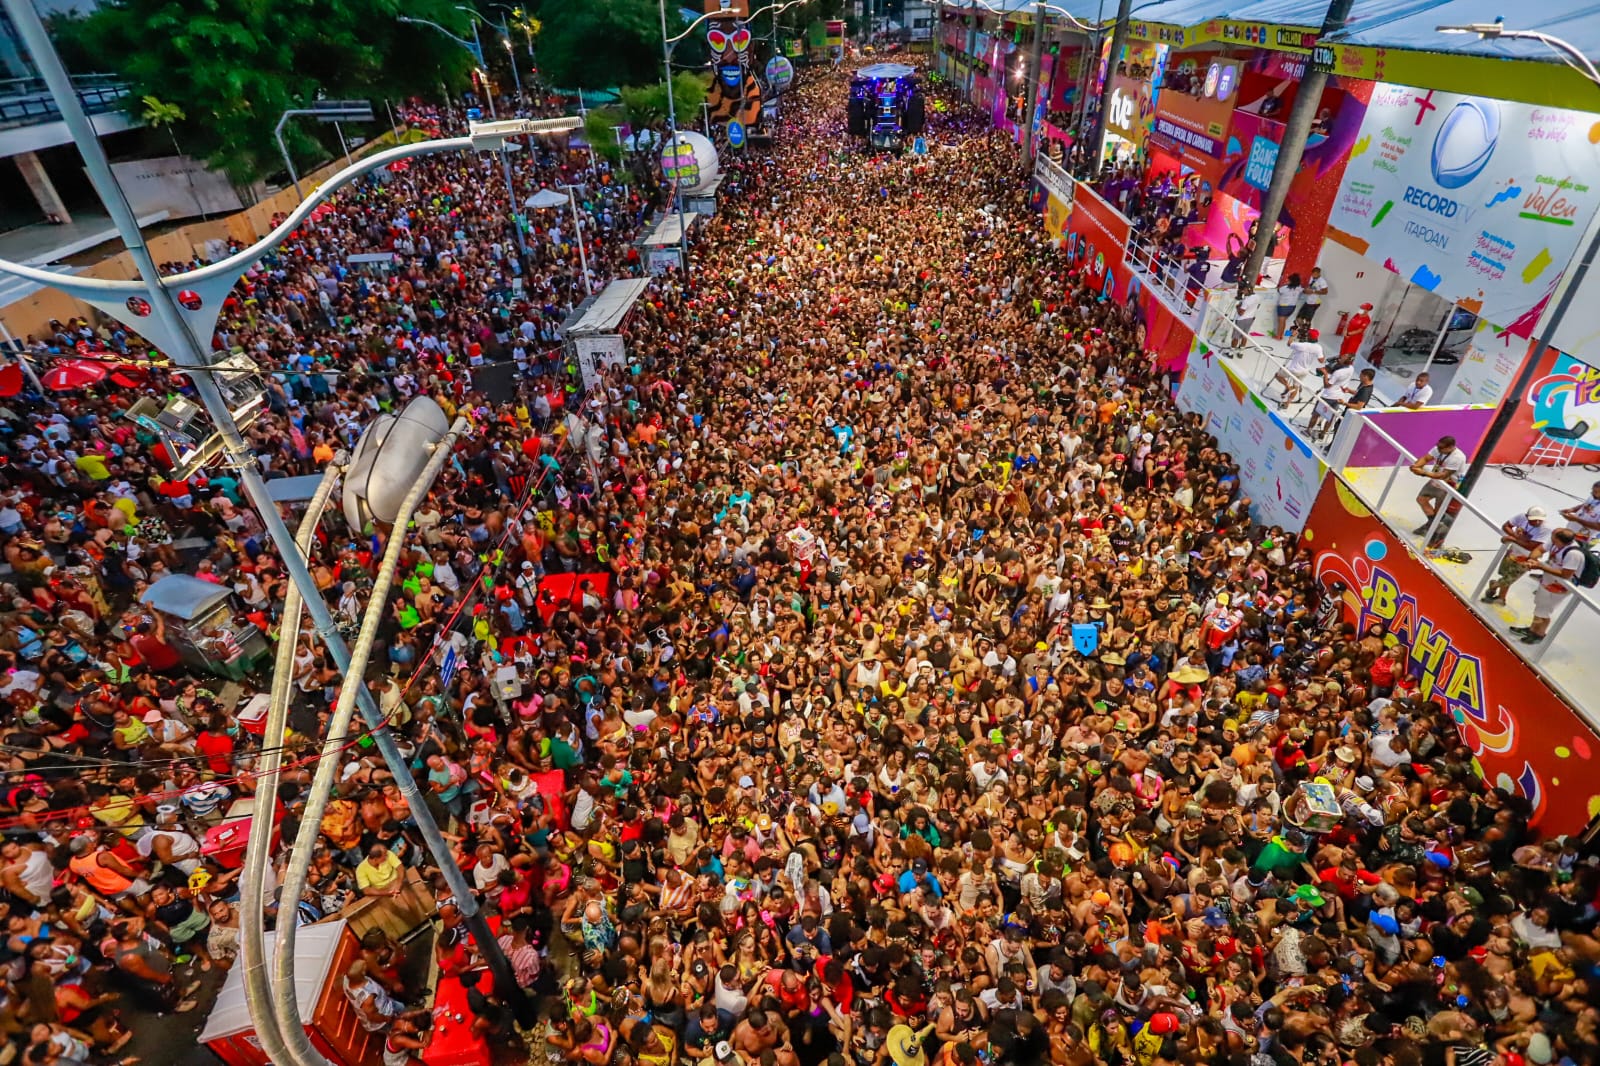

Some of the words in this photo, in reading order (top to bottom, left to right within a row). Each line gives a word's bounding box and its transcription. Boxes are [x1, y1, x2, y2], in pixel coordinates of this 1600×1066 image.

[1177, 61, 1196, 76] sbt
[1109, 87, 1132, 130] tve
[1403, 186, 1458, 218] RECORD
[1404, 220, 1450, 249] ITAPOAN
[1369, 572, 1483, 715] BAHIA
